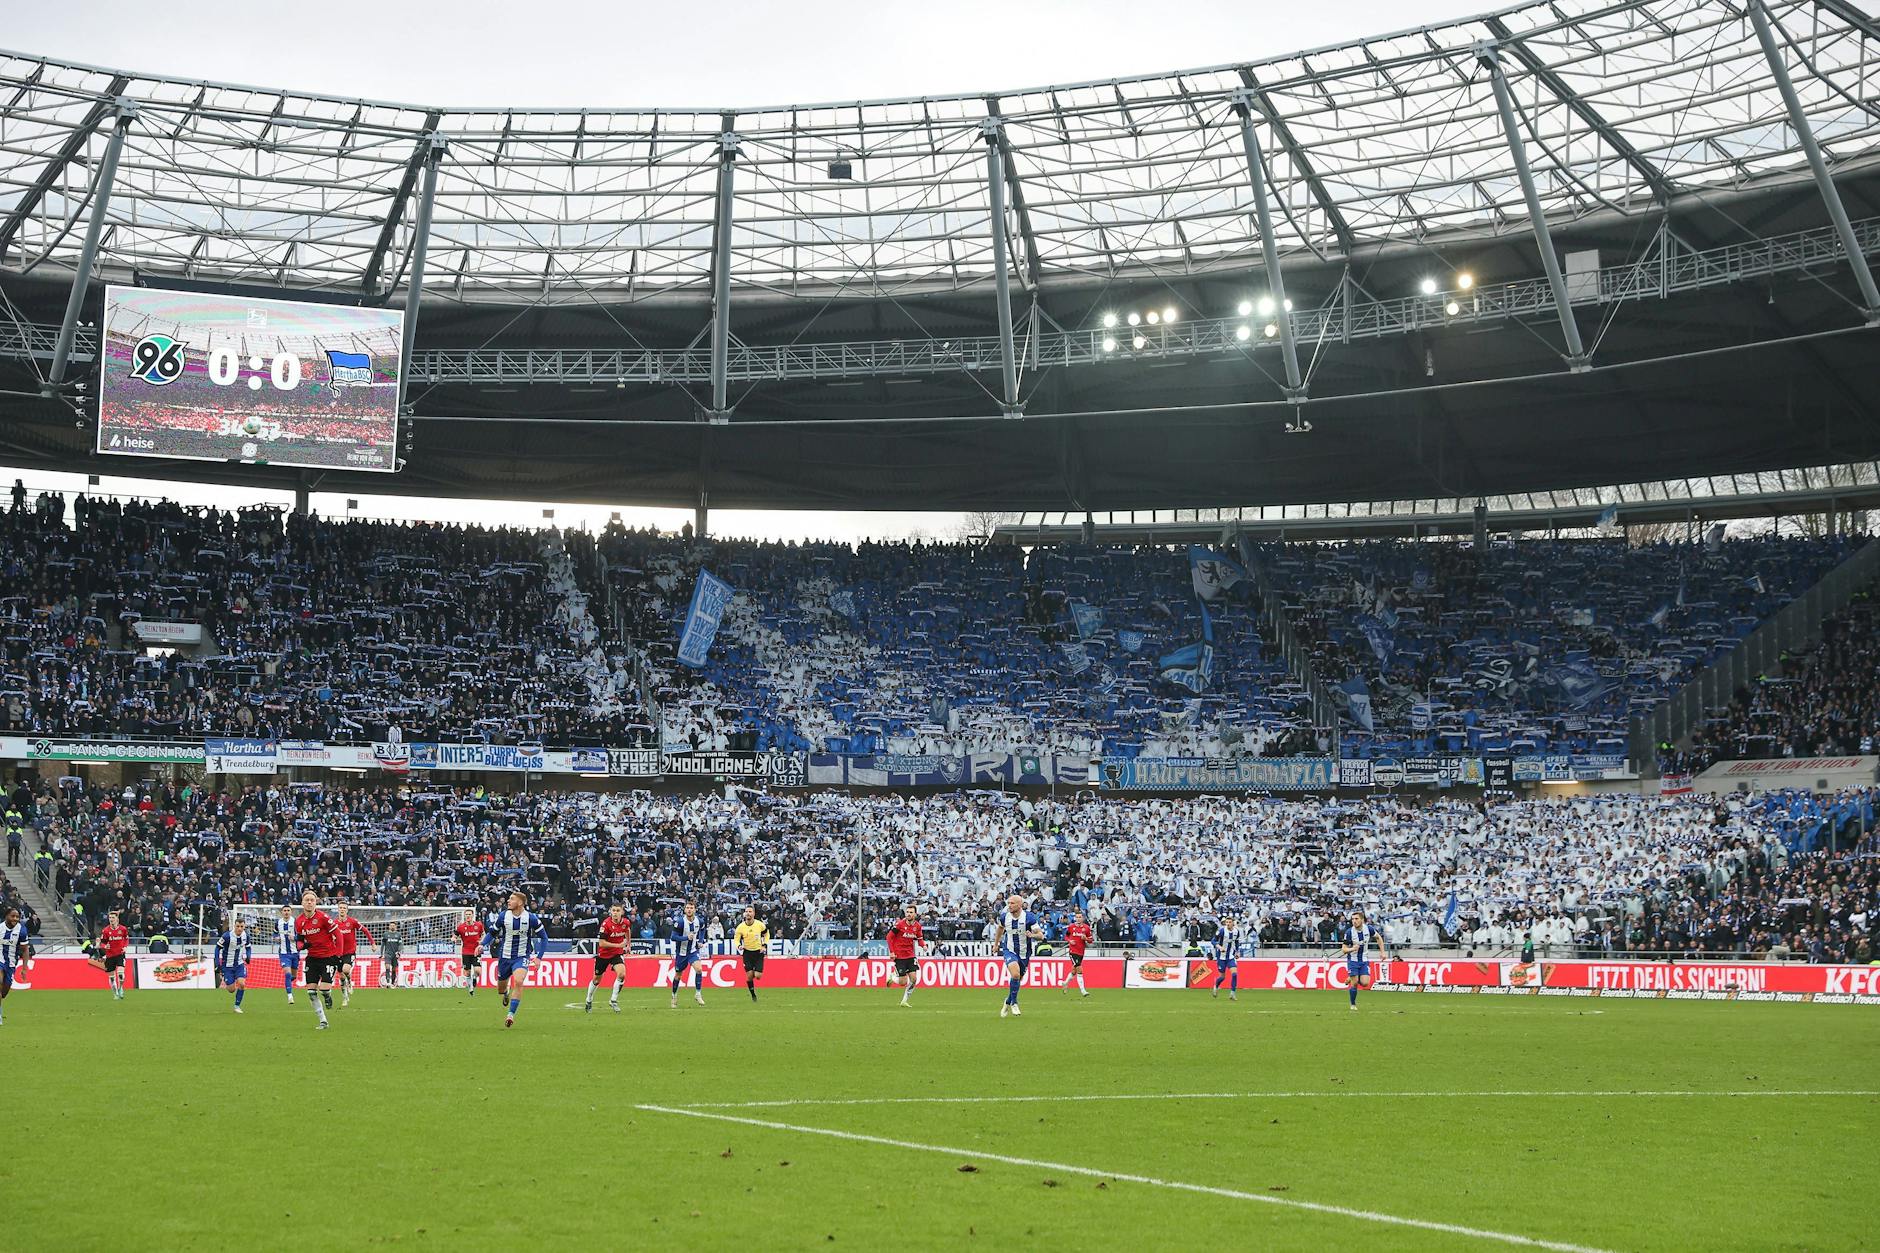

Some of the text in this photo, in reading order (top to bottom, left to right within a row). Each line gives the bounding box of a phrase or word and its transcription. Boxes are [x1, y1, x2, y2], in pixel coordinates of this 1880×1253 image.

[132, 338, 184, 379] 96
[124, 437, 154, 449] heise
[35, 740, 52, 757] 96
[69, 743, 109, 757] FANS
[115, 744, 168, 759] GEGEN
[224, 741, 263, 754] Hertha
[609, 751, 657, 762] YOUNG
[225, 759, 274, 769] Trendelburg
[672, 757, 754, 773] HOOLIGANS
[1728, 758, 1863, 772] HEINZ VON HEIDEN
[772, 774, 804, 786] 1997
[326, 965, 334, 975] 16
[807, 961, 849, 986] KFC
[855, 961, 897, 986] APP
[1272, 962, 1349, 988] KFC
[1407, 963, 1452, 985] KFC
[1813, 992, 1854, 1003] Eisenbach
